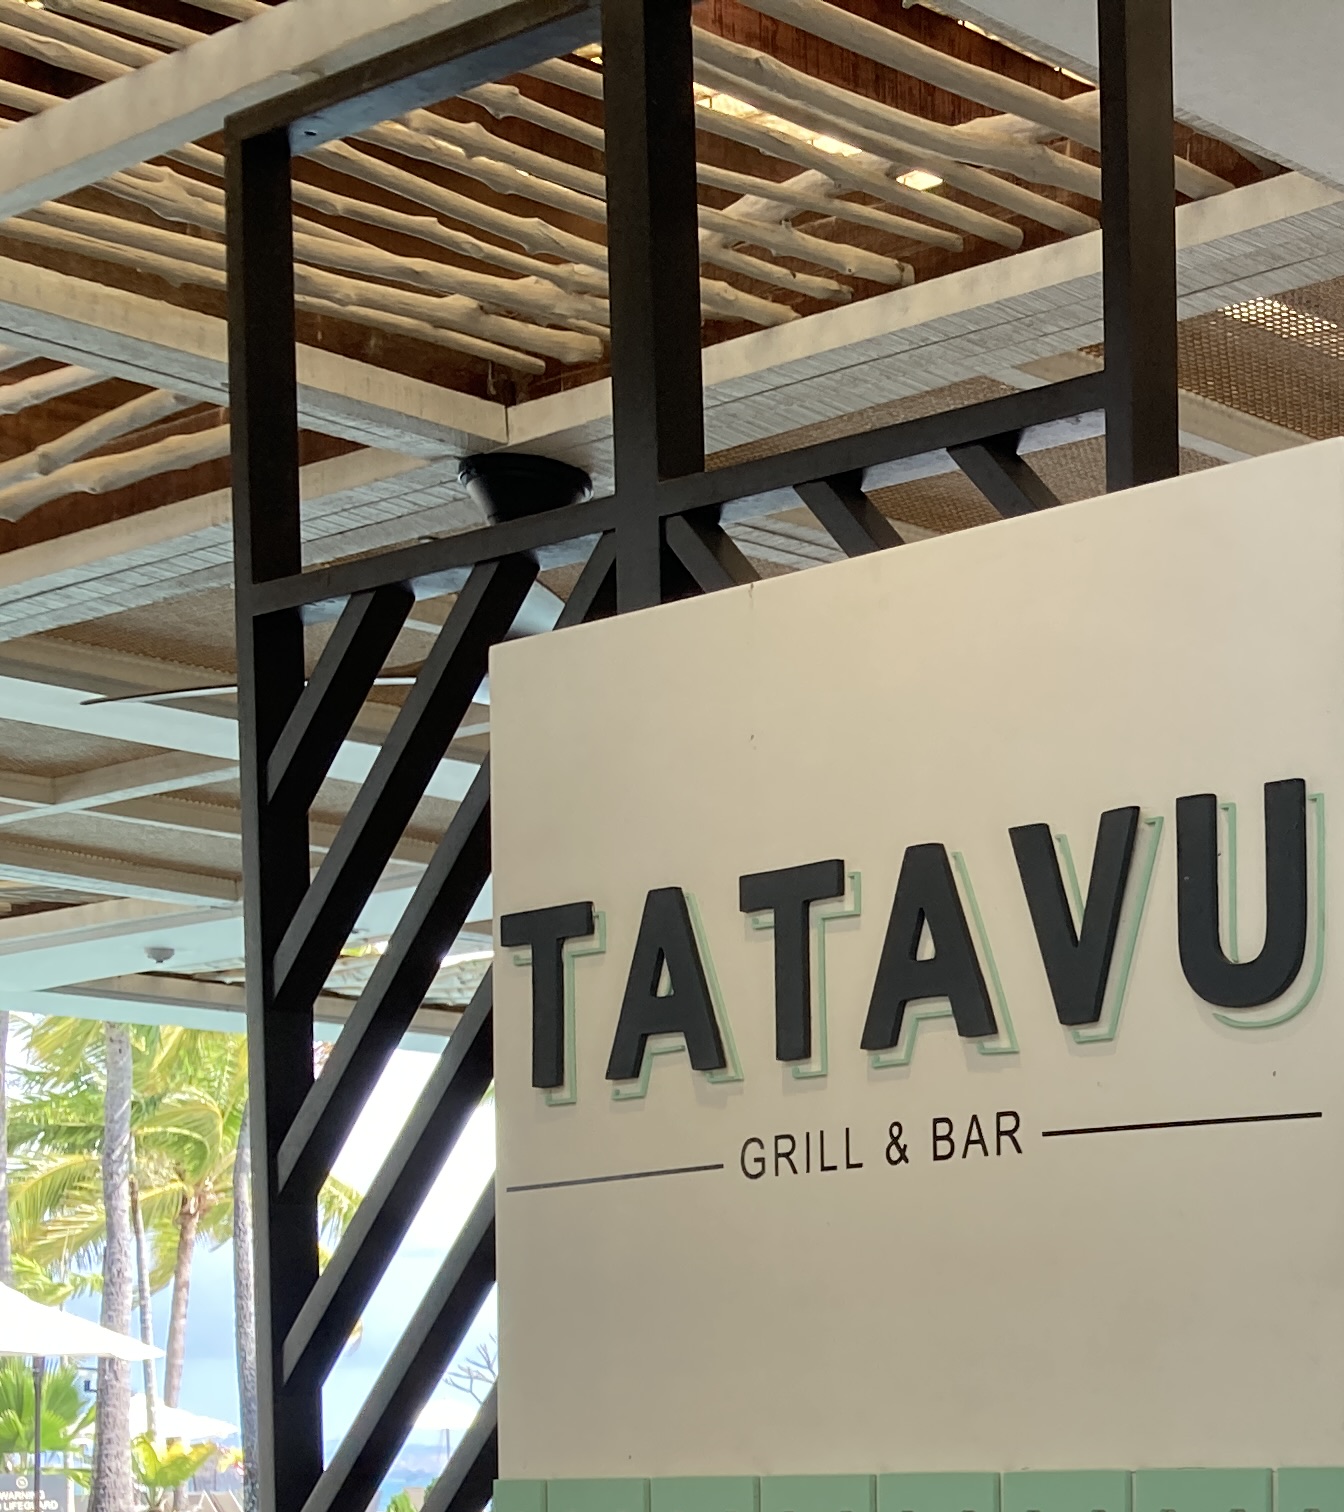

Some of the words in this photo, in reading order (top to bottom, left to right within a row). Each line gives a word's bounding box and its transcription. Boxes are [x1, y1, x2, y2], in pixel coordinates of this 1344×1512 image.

[500, 777, 1310, 1090] TATAVU
[740, 1127, 863, 1180] GRILL
[885, 1121, 909, 1166] &
[932, 1110, 1023, 1161] BAR
